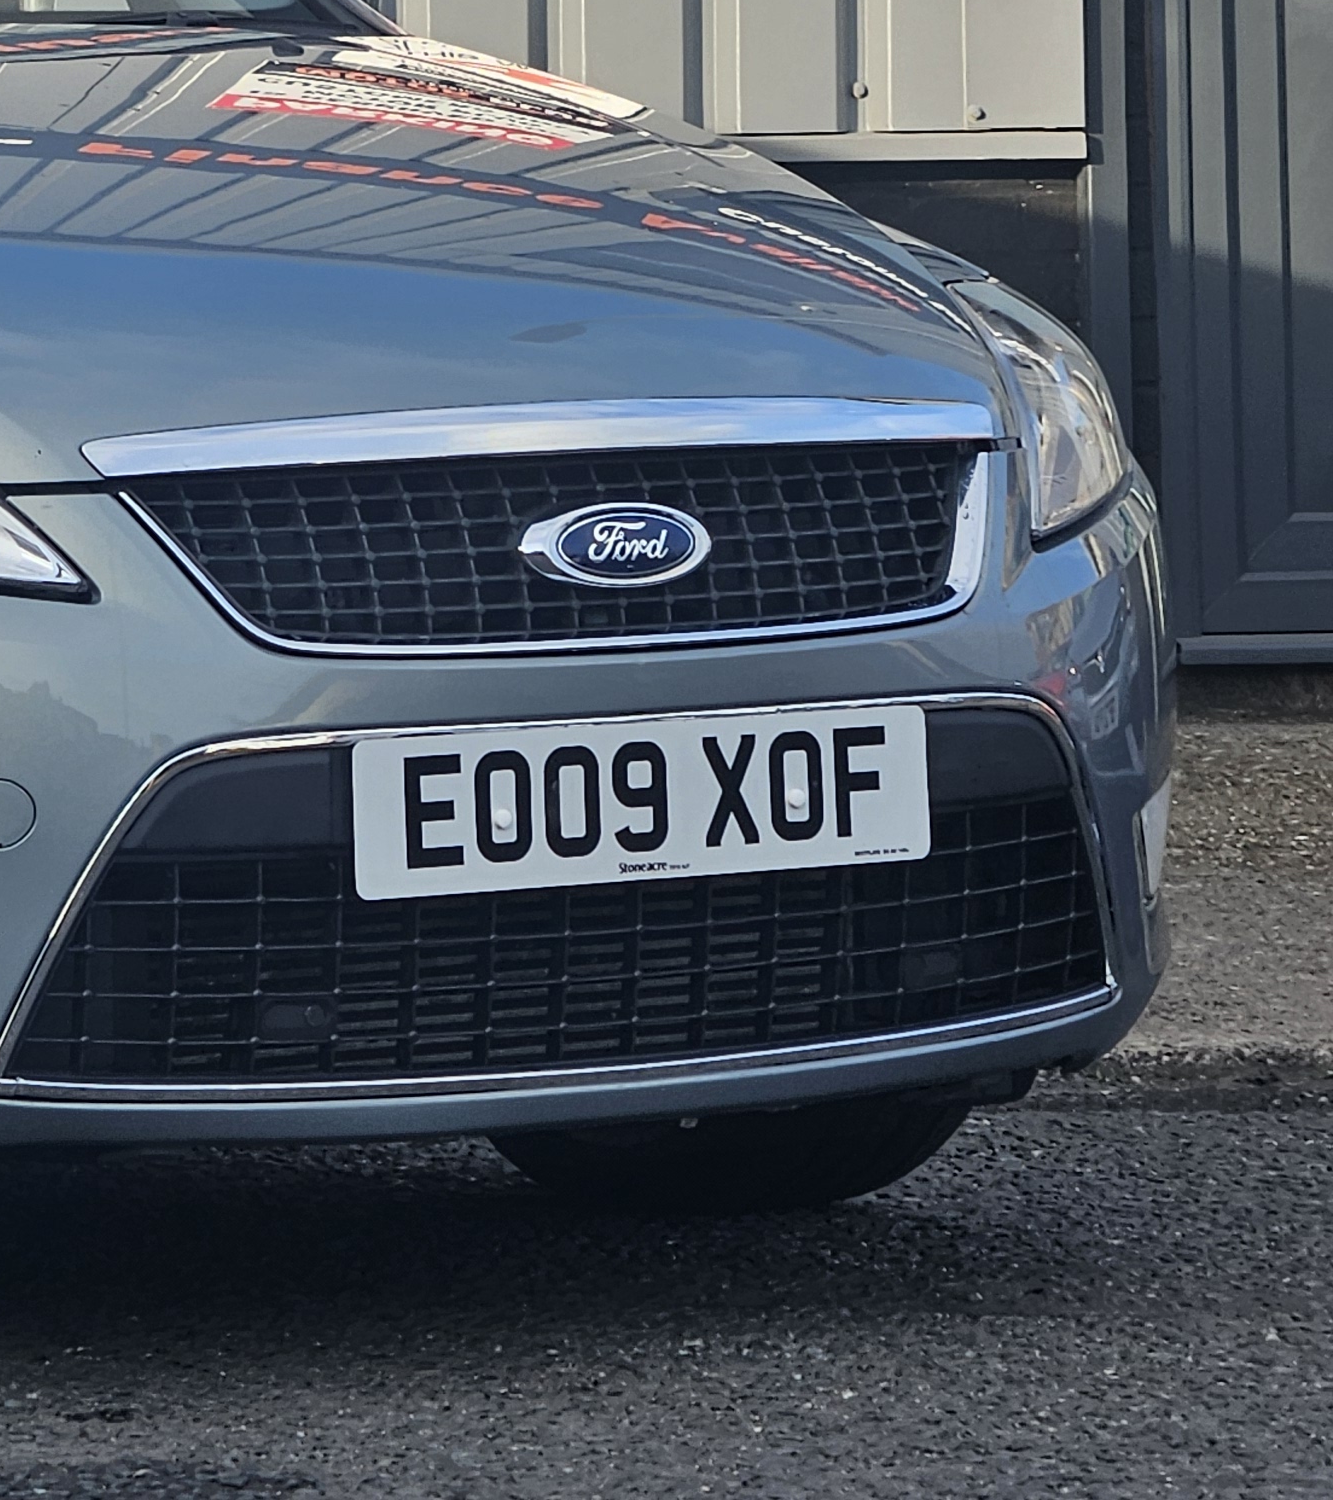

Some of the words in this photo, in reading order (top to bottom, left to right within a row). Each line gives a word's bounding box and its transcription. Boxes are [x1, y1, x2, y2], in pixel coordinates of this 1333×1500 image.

[588, 521, 669, 563] Ford
[702, 725, 886, 848] XOF
[617, 861, 668, 874] Stoneacre
